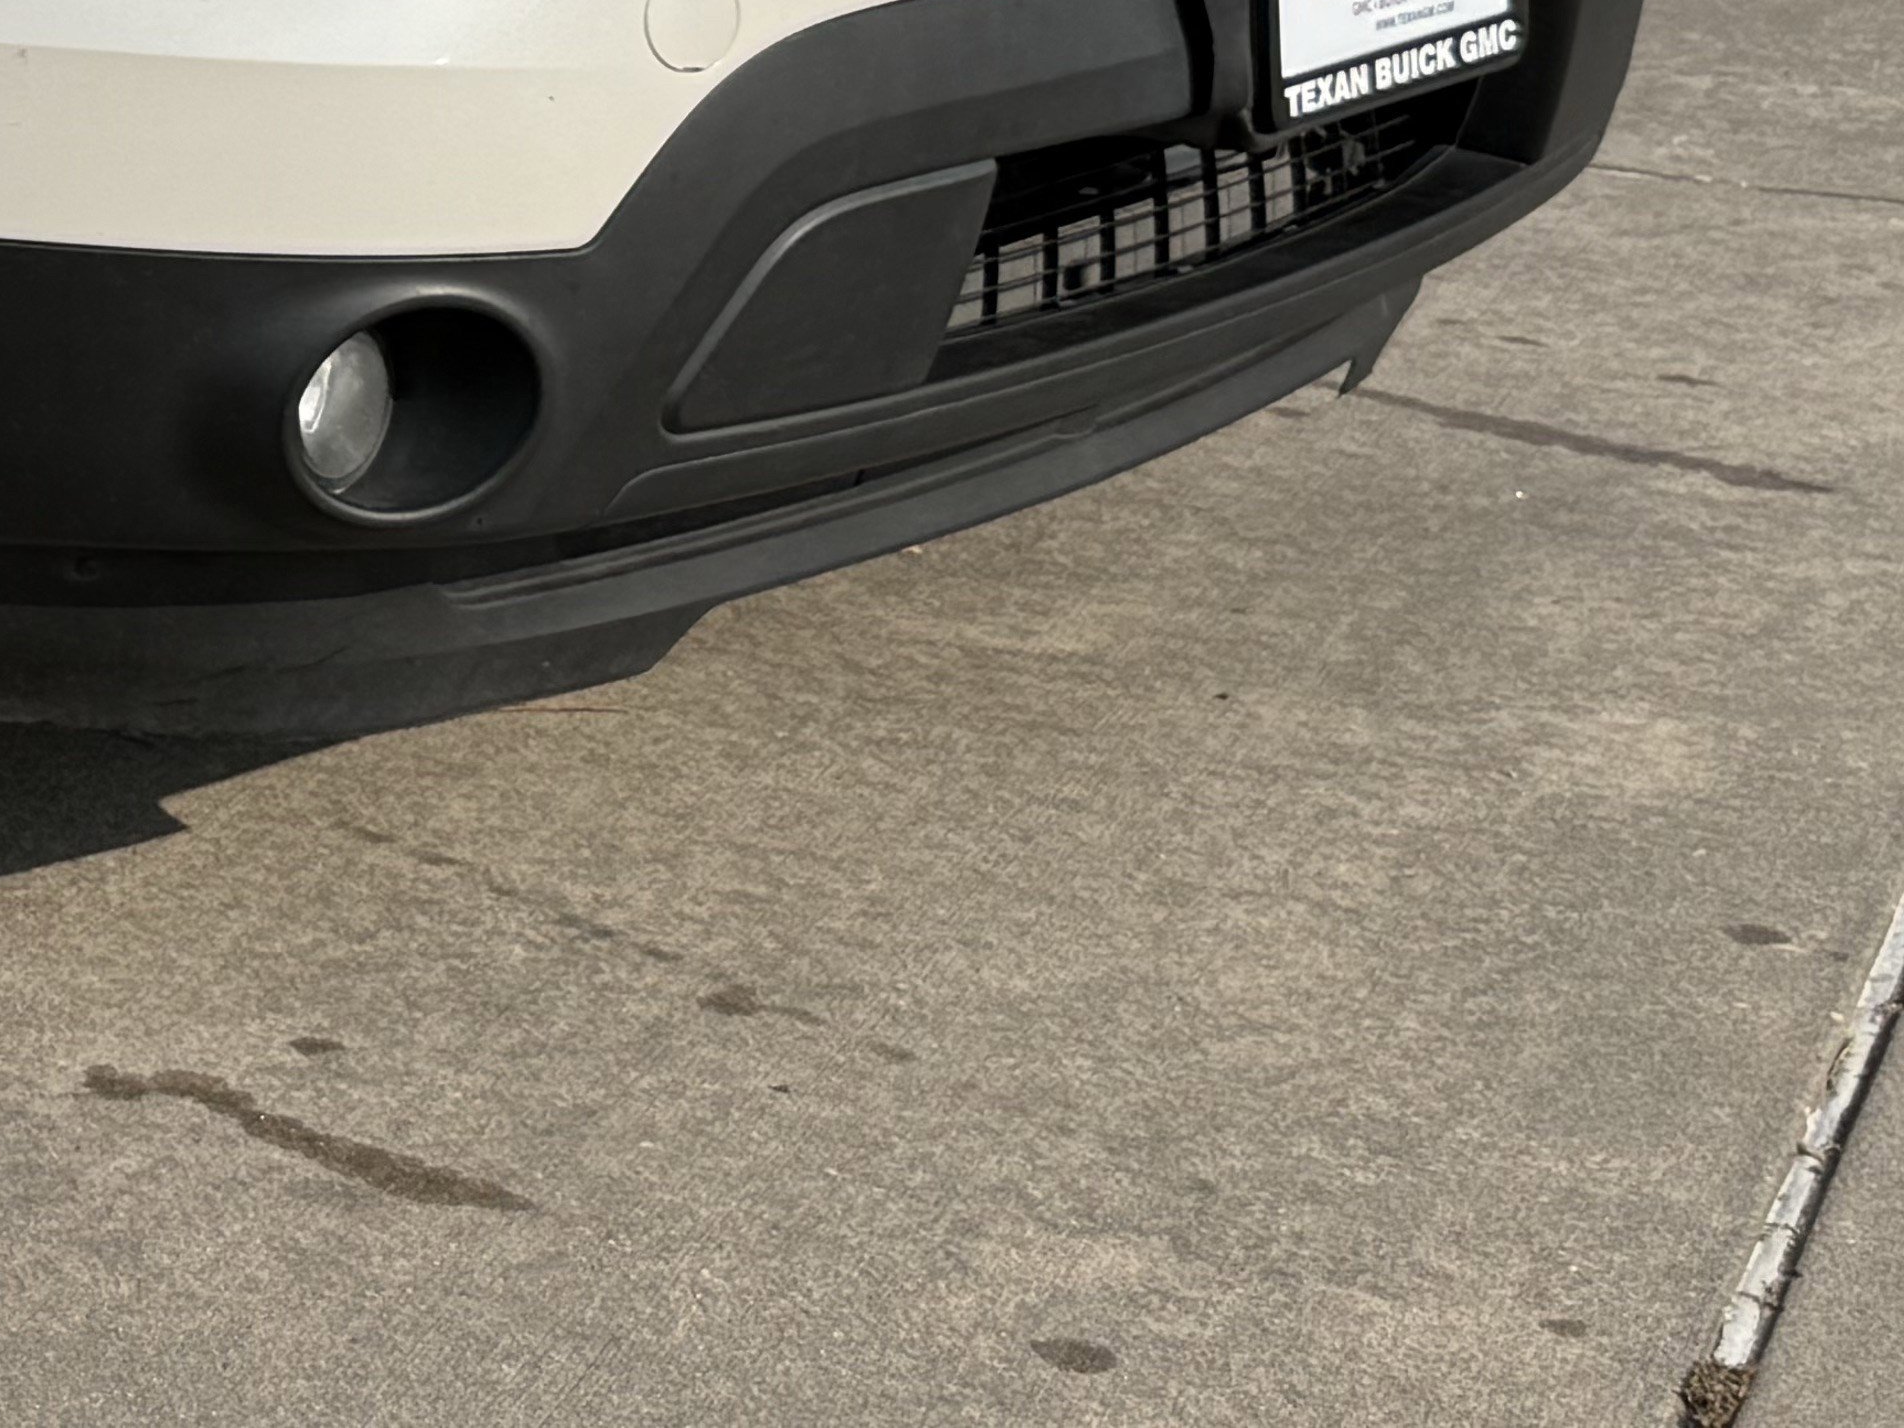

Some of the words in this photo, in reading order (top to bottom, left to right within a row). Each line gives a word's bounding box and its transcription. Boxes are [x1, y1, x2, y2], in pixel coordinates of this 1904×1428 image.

[1284, 63, 1370, 117] TEXAN
[1374, 37, 1459, 90] BUICK
[1459, 19, 1518, 63] GMC
